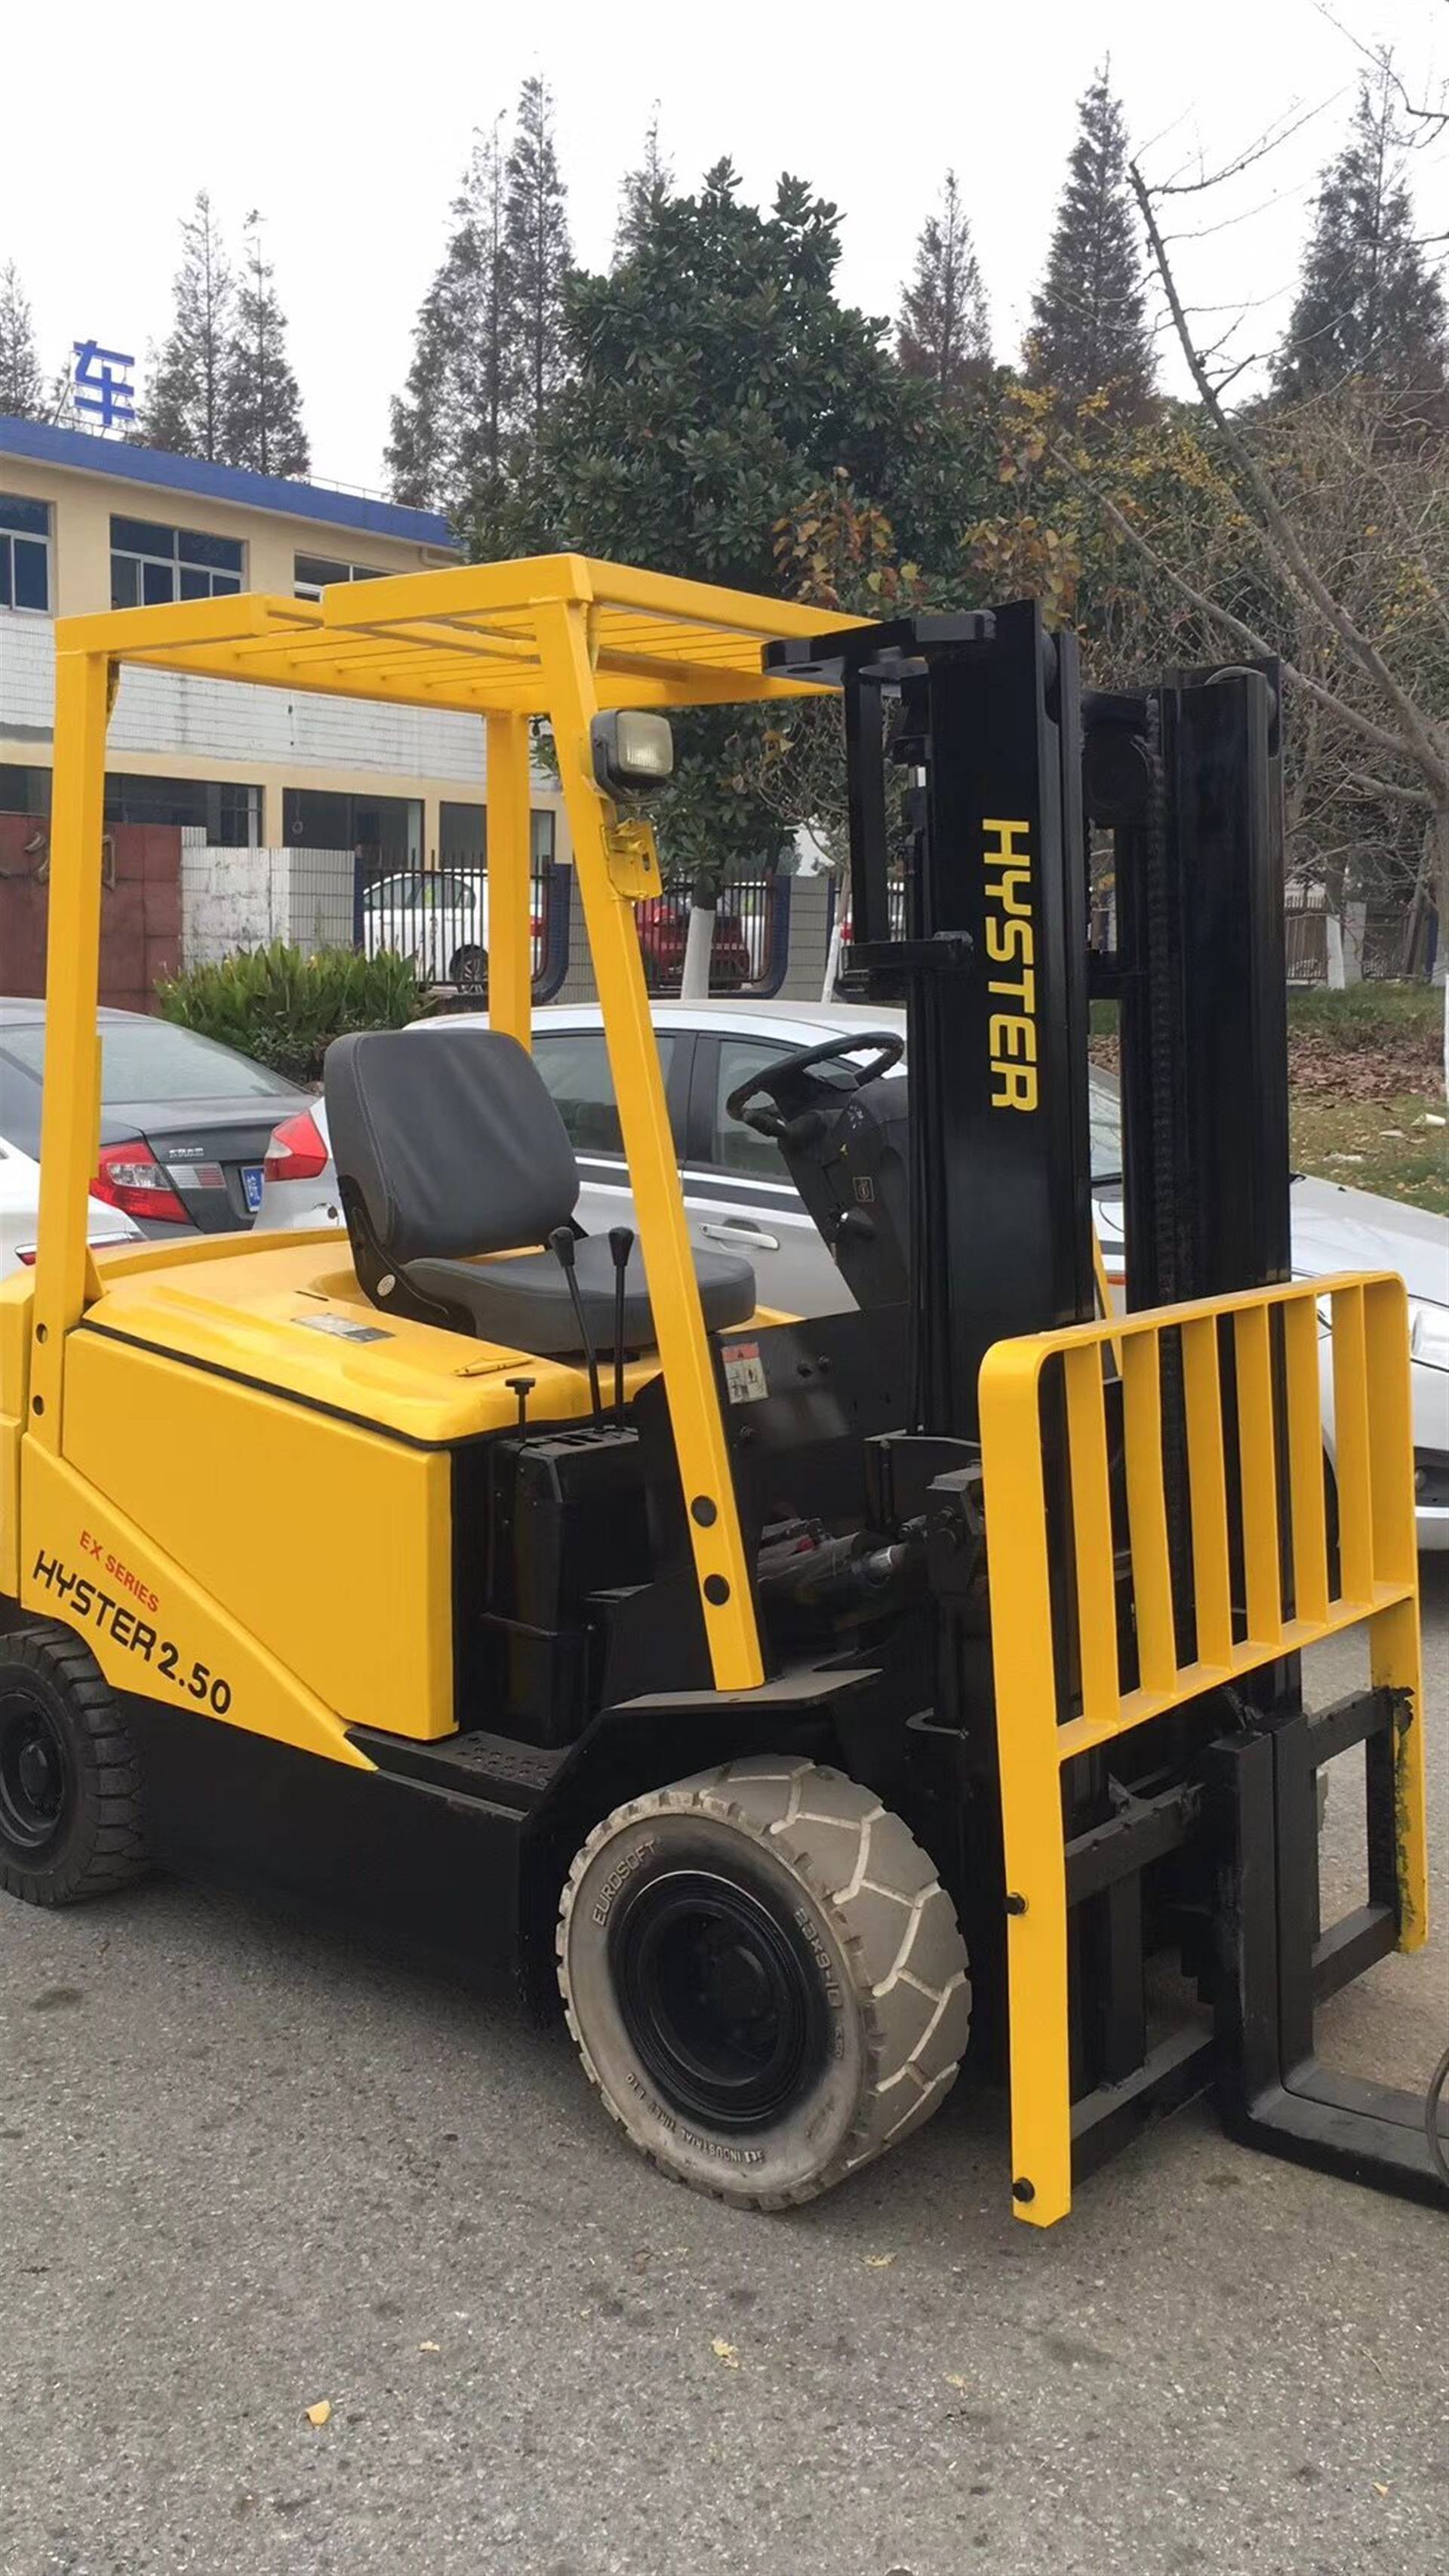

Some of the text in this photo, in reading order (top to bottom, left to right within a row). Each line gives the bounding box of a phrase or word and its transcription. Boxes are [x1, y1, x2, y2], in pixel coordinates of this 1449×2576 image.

[73, 339, 135, 426] 车
[982, 818, 1039, 1113] HYSTER
[79, 1531, 161, 1614] EX SERIES
[32, 1549, 232, 1715] HYSTER 2.50
[592, 1840, 656, 1927] EUROSOFT
[681, 2126, 743, 2163] INDUSTRIAL
